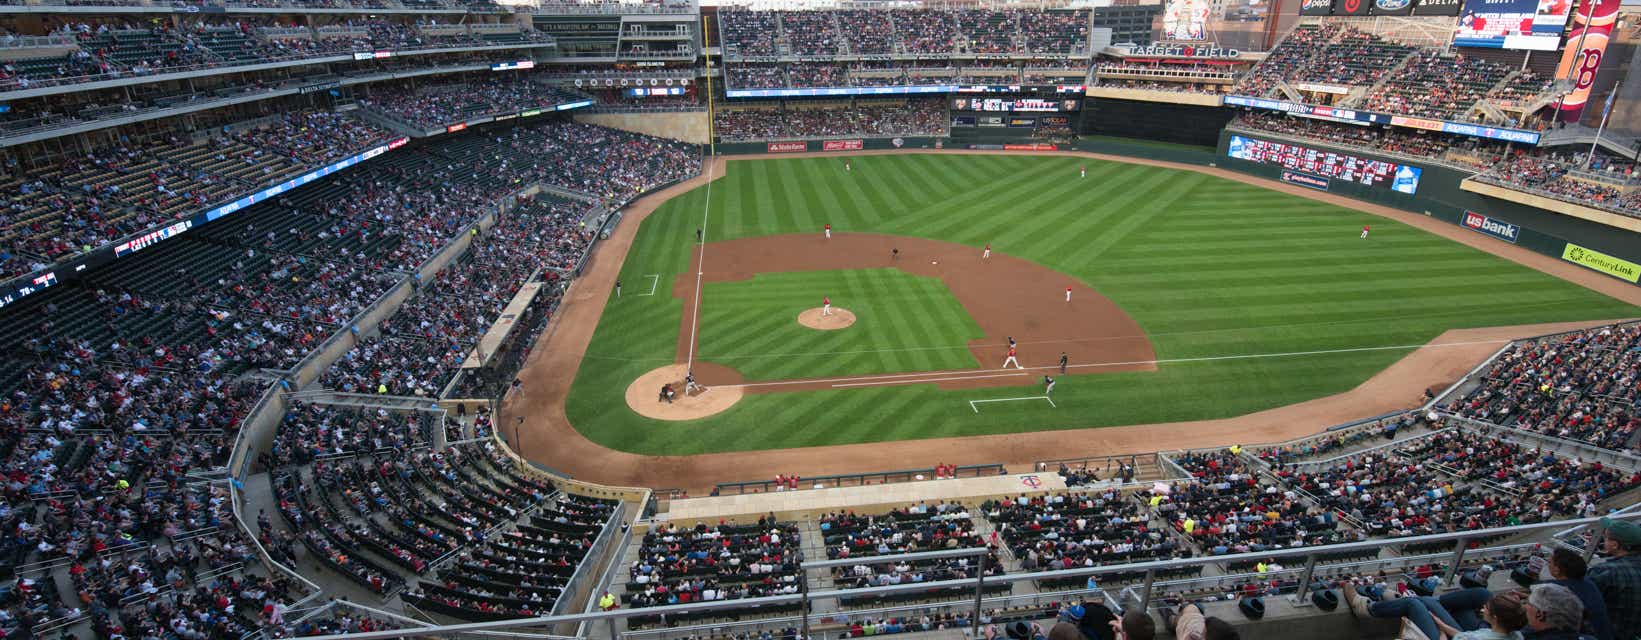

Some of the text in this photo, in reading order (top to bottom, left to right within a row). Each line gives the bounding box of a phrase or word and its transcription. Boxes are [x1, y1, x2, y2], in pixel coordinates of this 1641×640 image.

[1130, 46, 1239, 57] TARGET FIELD
[1584, 253, 1633, 277] CenturyLink
